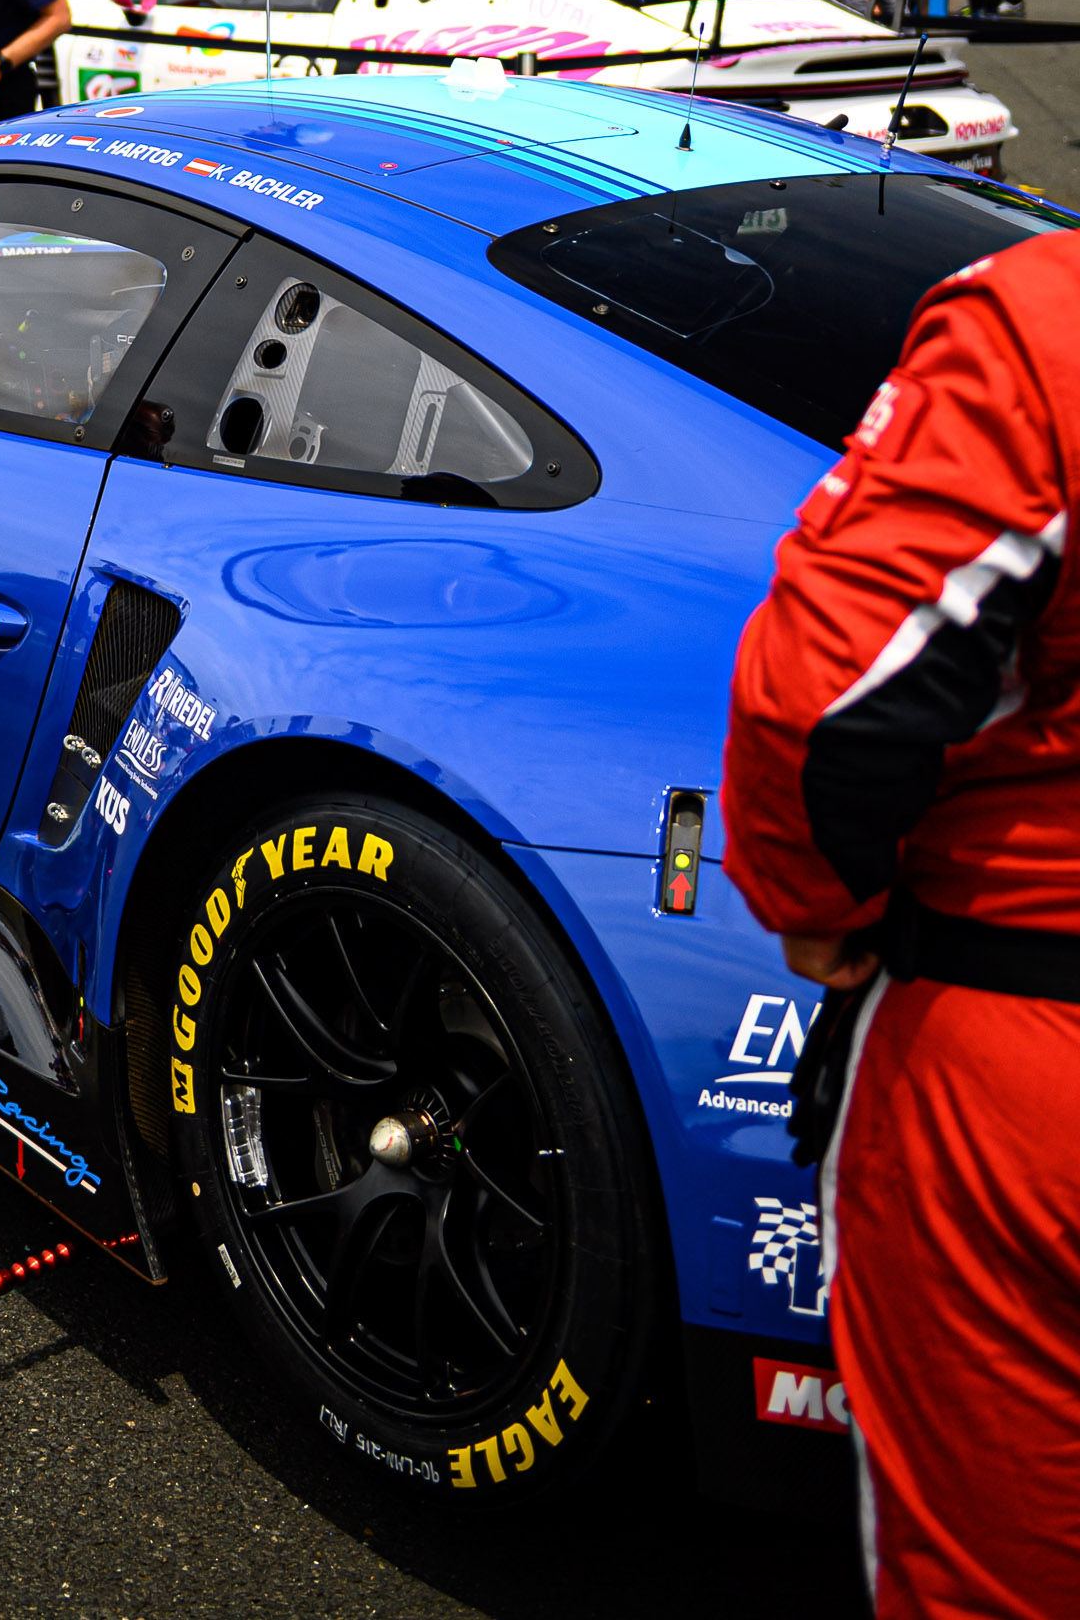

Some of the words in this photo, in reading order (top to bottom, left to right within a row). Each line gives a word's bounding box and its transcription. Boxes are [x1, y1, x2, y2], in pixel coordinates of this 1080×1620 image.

[13, 133, 28, 147] A.
[30, 133, 65, 149] AU
[86, 137, 99, 153] L.
[103, 140, 184, 167] HARTOG
[208, 164, 232, 182] K.
[228, 170, 324, 211] BACHLER
[1, 246, 73, 257] MANTHEY
[123, 718, 168, 772] ENDLESS
[172, 826, 395, 1052] GOODYEAR
[697, 1088, 793, 1118] Advanced
[447, 1357, 590, 1489] EAGLE
